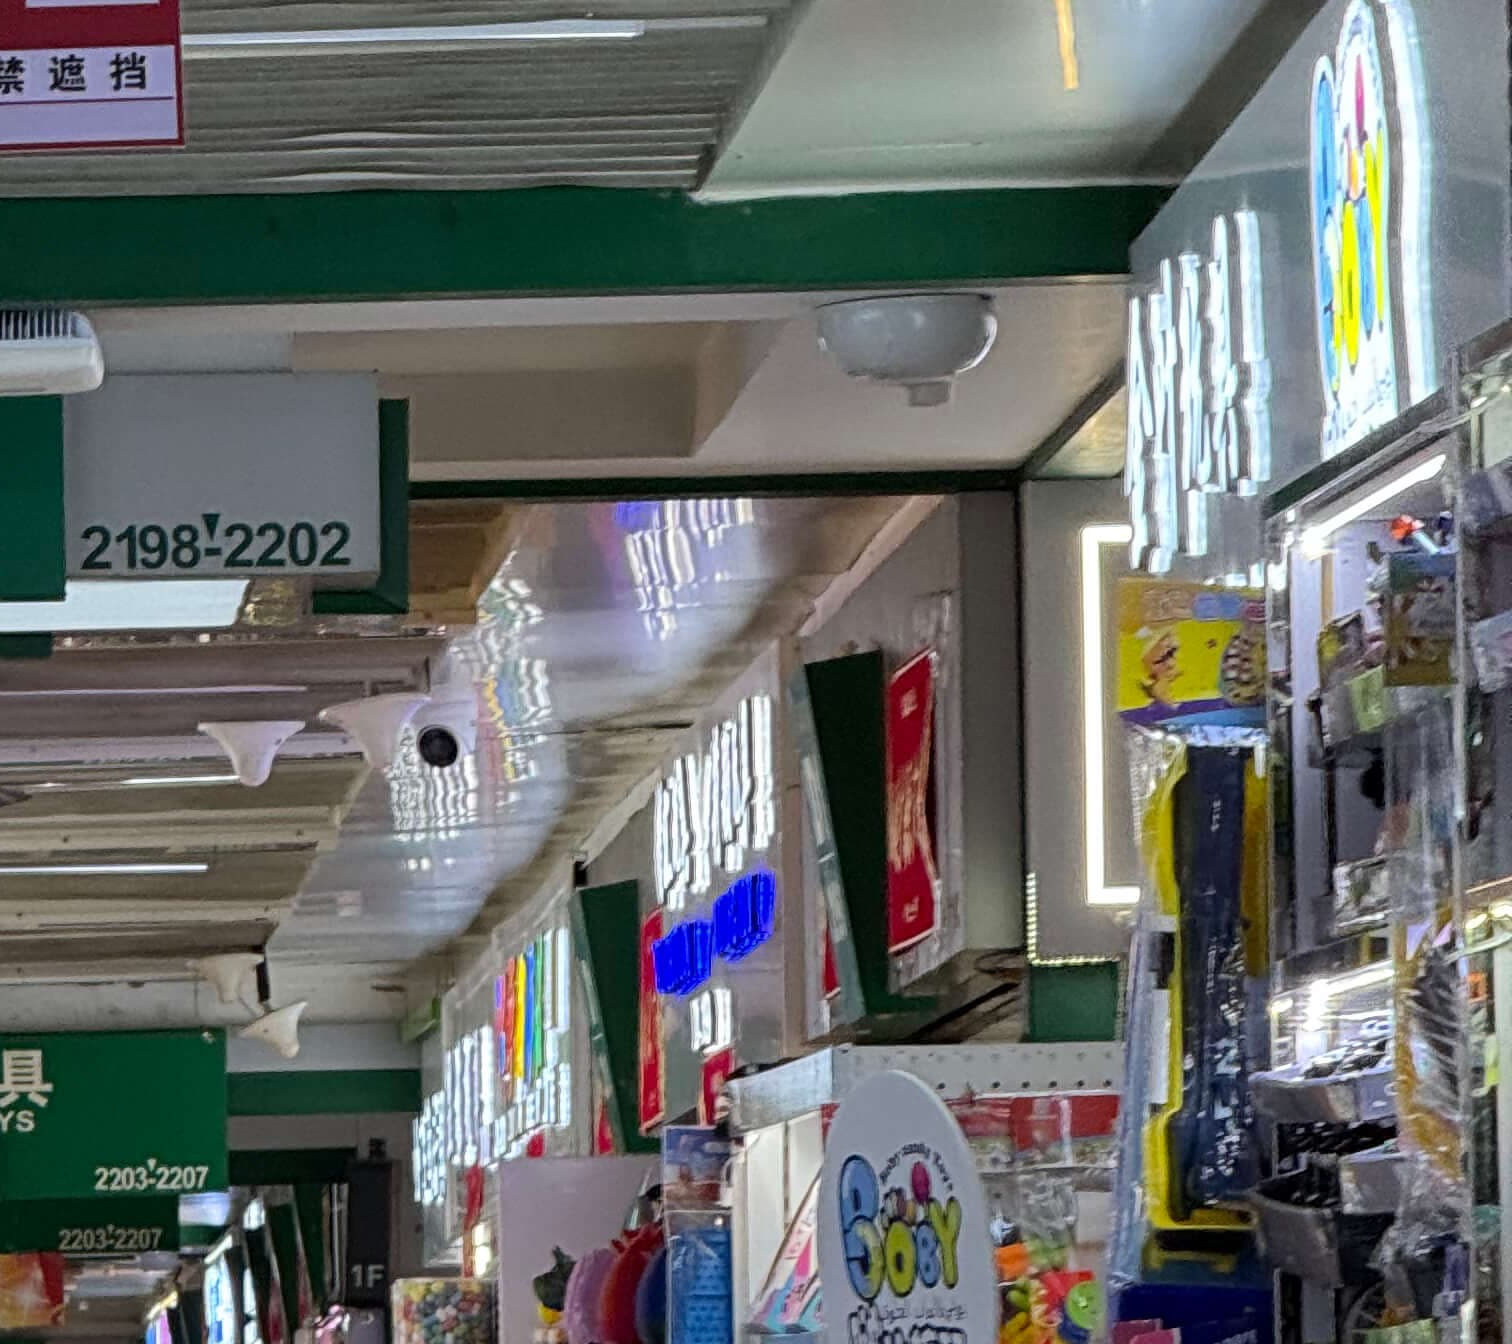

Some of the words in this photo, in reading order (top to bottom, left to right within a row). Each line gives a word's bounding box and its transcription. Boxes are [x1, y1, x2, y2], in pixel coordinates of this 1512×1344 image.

[79, 520, 351, 570] 2198-2202
[93, 1166, 210, 1191] 2203-2207
[58, 1228, 163, 1250] 2203-2207
[351, 1263, 385, 1289] 1F
